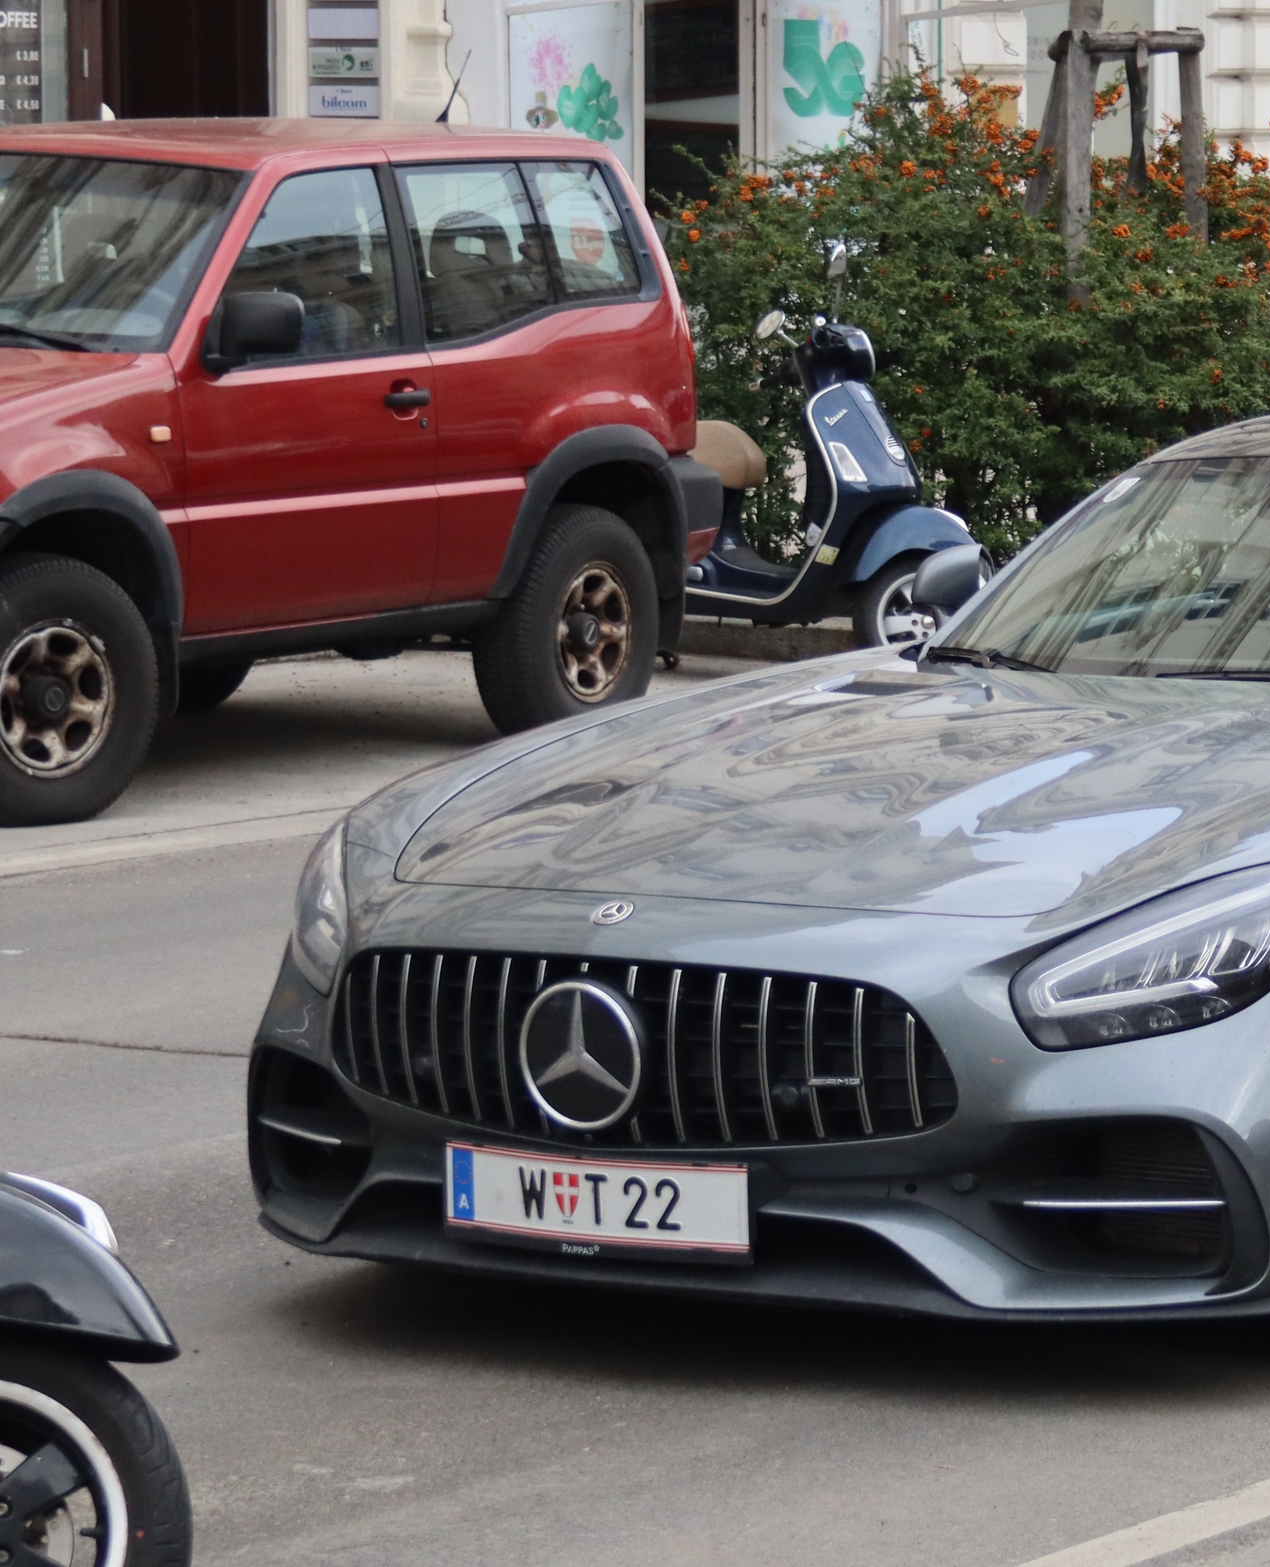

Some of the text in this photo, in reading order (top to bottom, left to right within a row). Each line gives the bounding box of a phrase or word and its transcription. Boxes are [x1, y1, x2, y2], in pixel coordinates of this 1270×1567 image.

[783, 18, 865, 118] 5G
[321, 95, 367, 108] bilcom
[458, 1193, 470, 1209] A
[562, 1243, 594, 1255] PAPPAS
